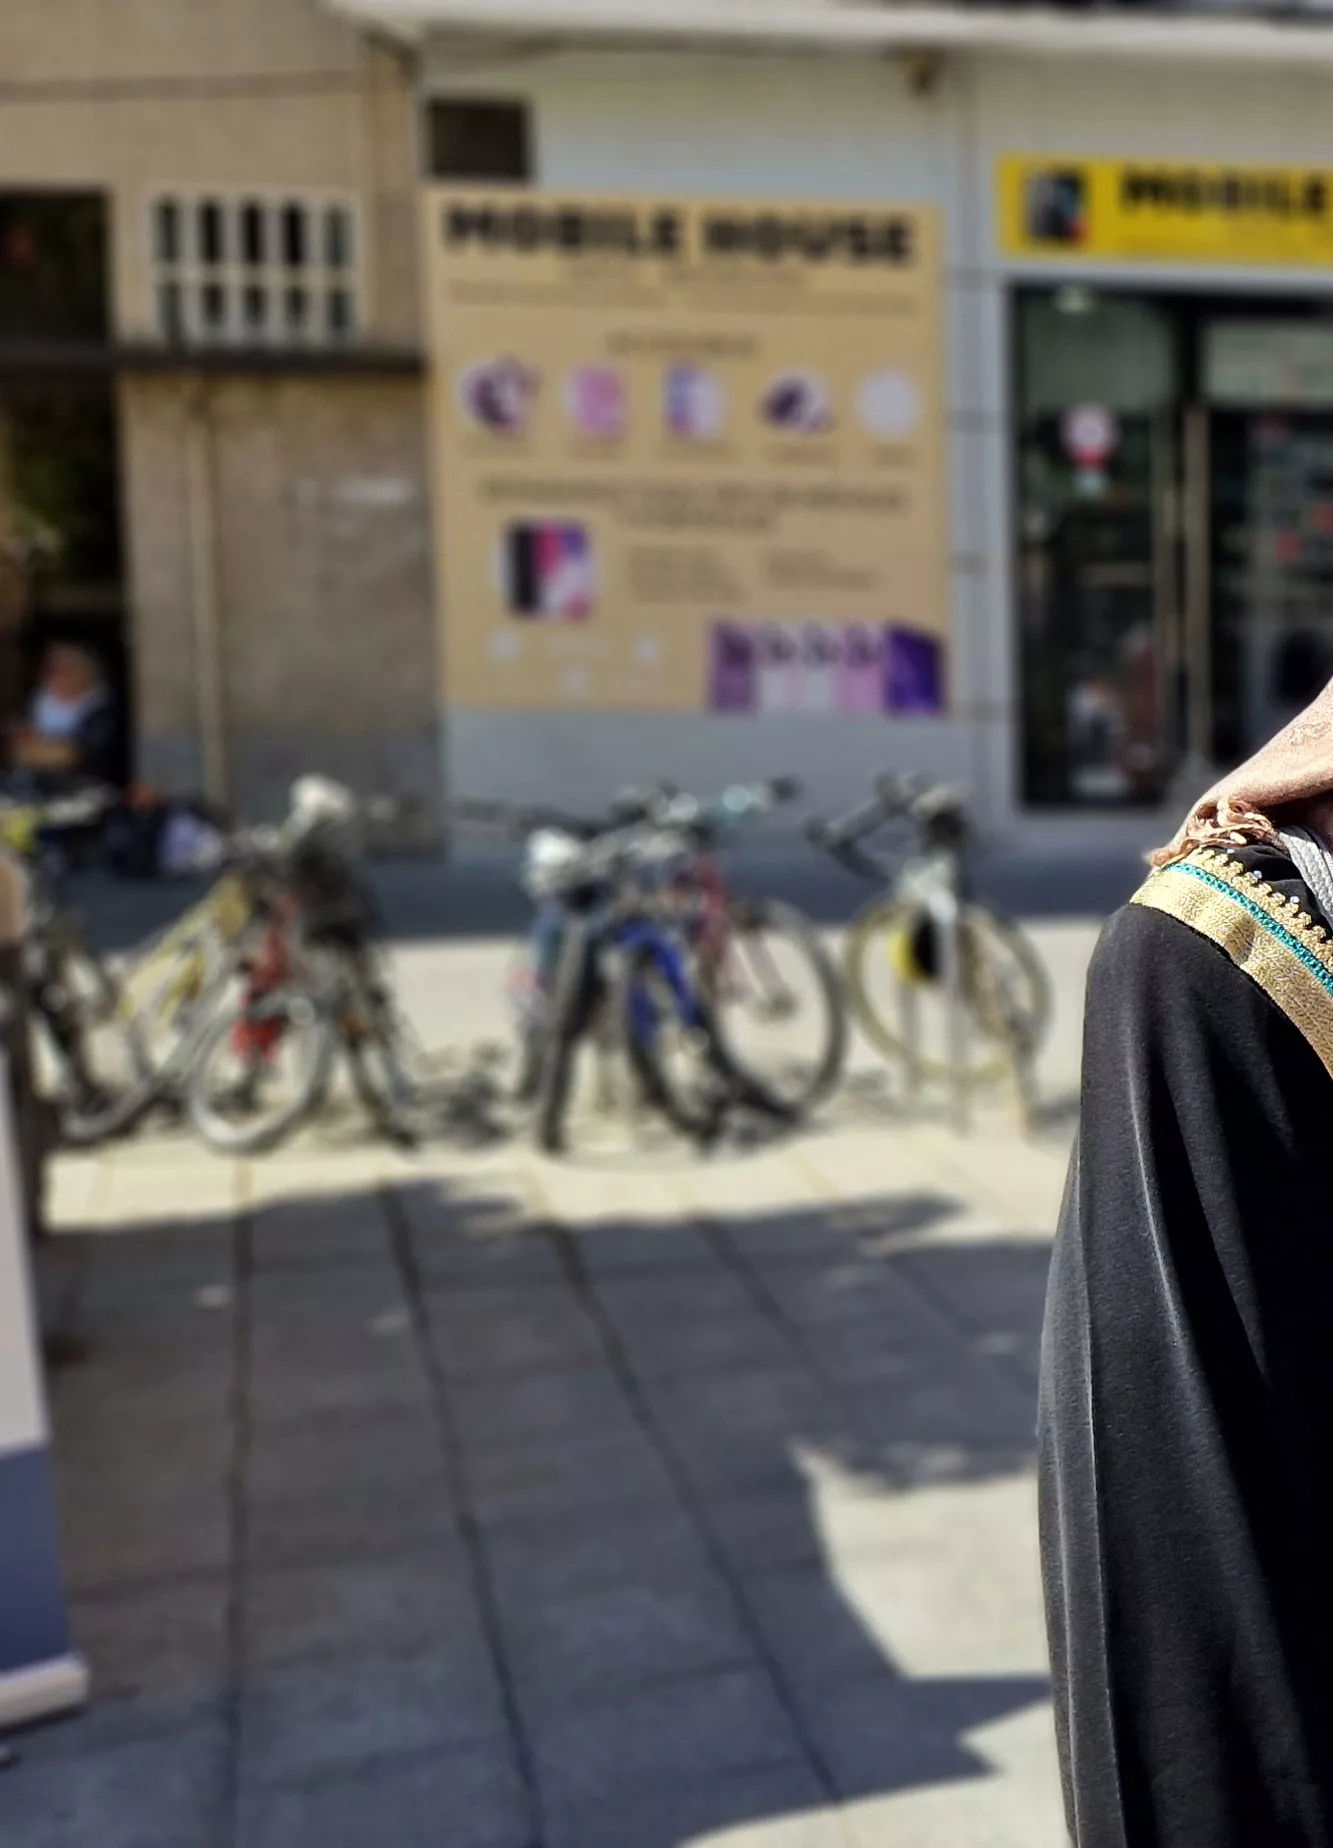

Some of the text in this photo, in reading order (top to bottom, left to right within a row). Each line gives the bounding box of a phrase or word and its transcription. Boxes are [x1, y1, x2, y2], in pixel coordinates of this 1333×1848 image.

[1123, 168, 1327, 217] MOBILE
[445, 206, 913, 266] MOBILE HOUSE
